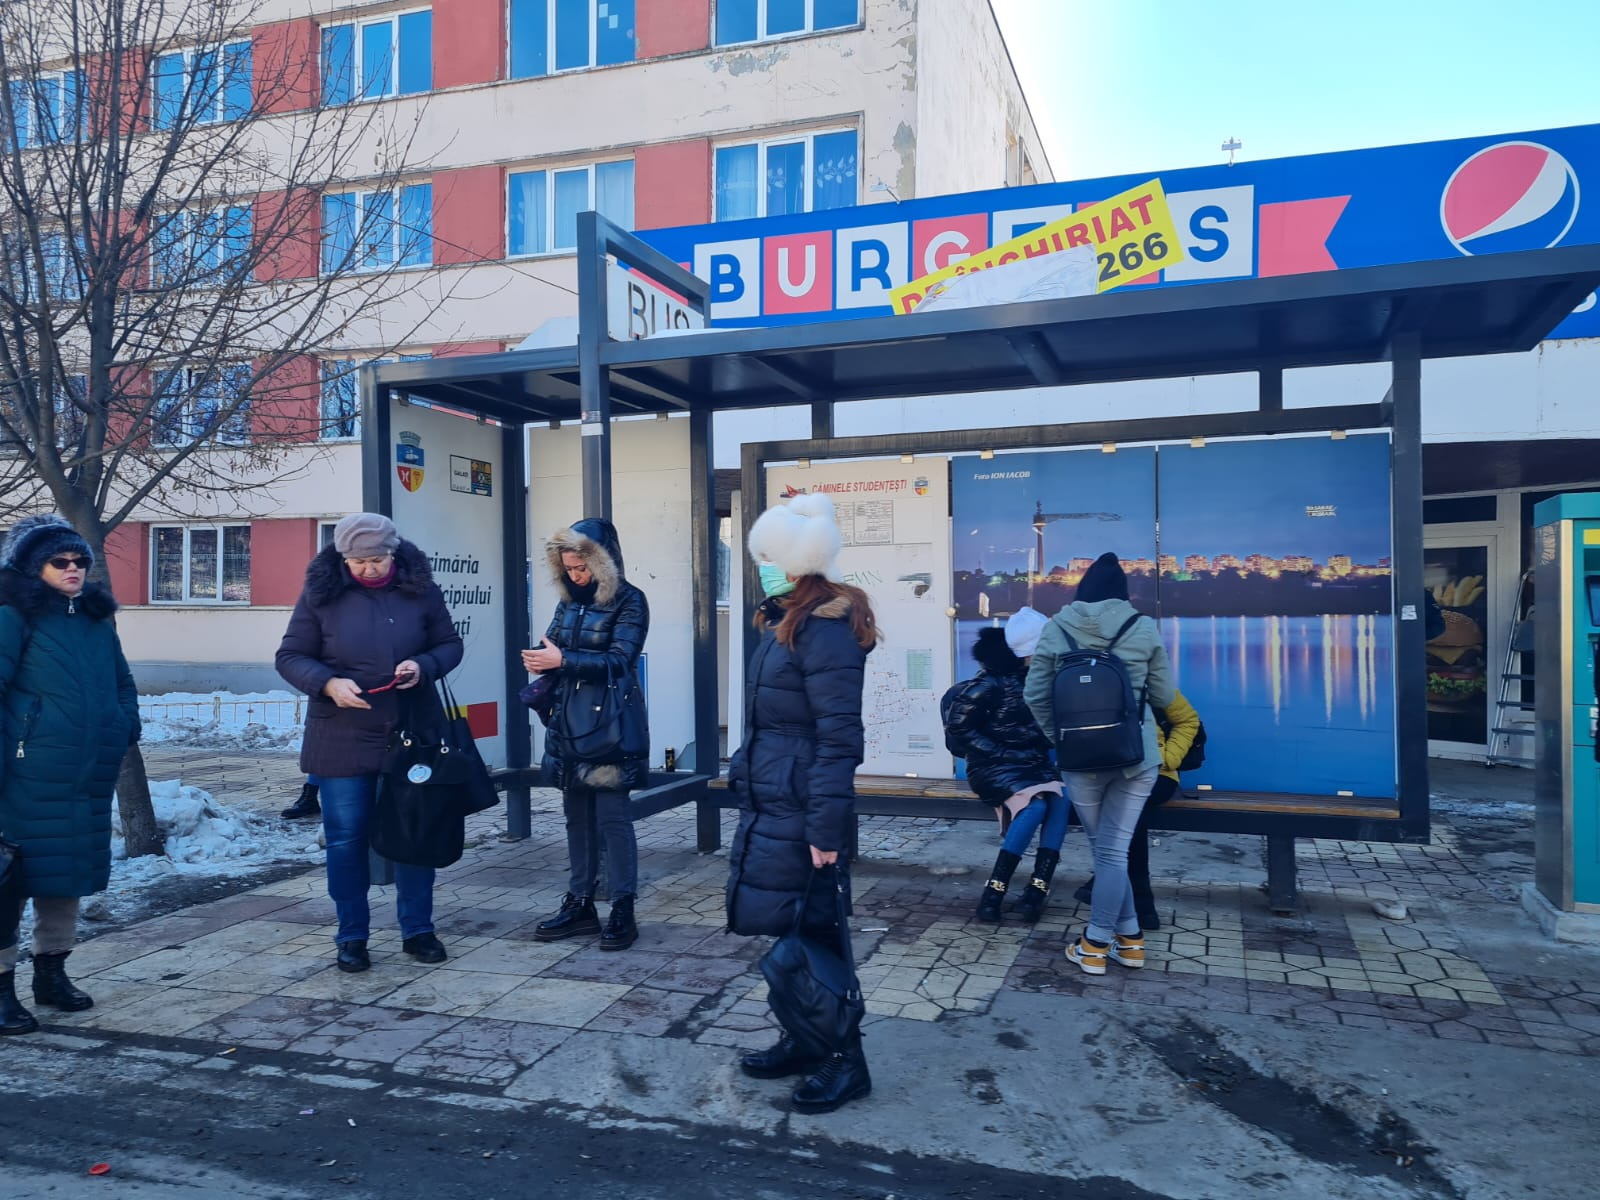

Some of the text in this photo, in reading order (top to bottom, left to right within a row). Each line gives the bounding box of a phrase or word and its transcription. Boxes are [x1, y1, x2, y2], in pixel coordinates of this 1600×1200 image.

[711, 204, 1229, 304] BURGS
[955, 194, 1153, 276] HIRIAT
[1096, 232, 1169, 282] 266
